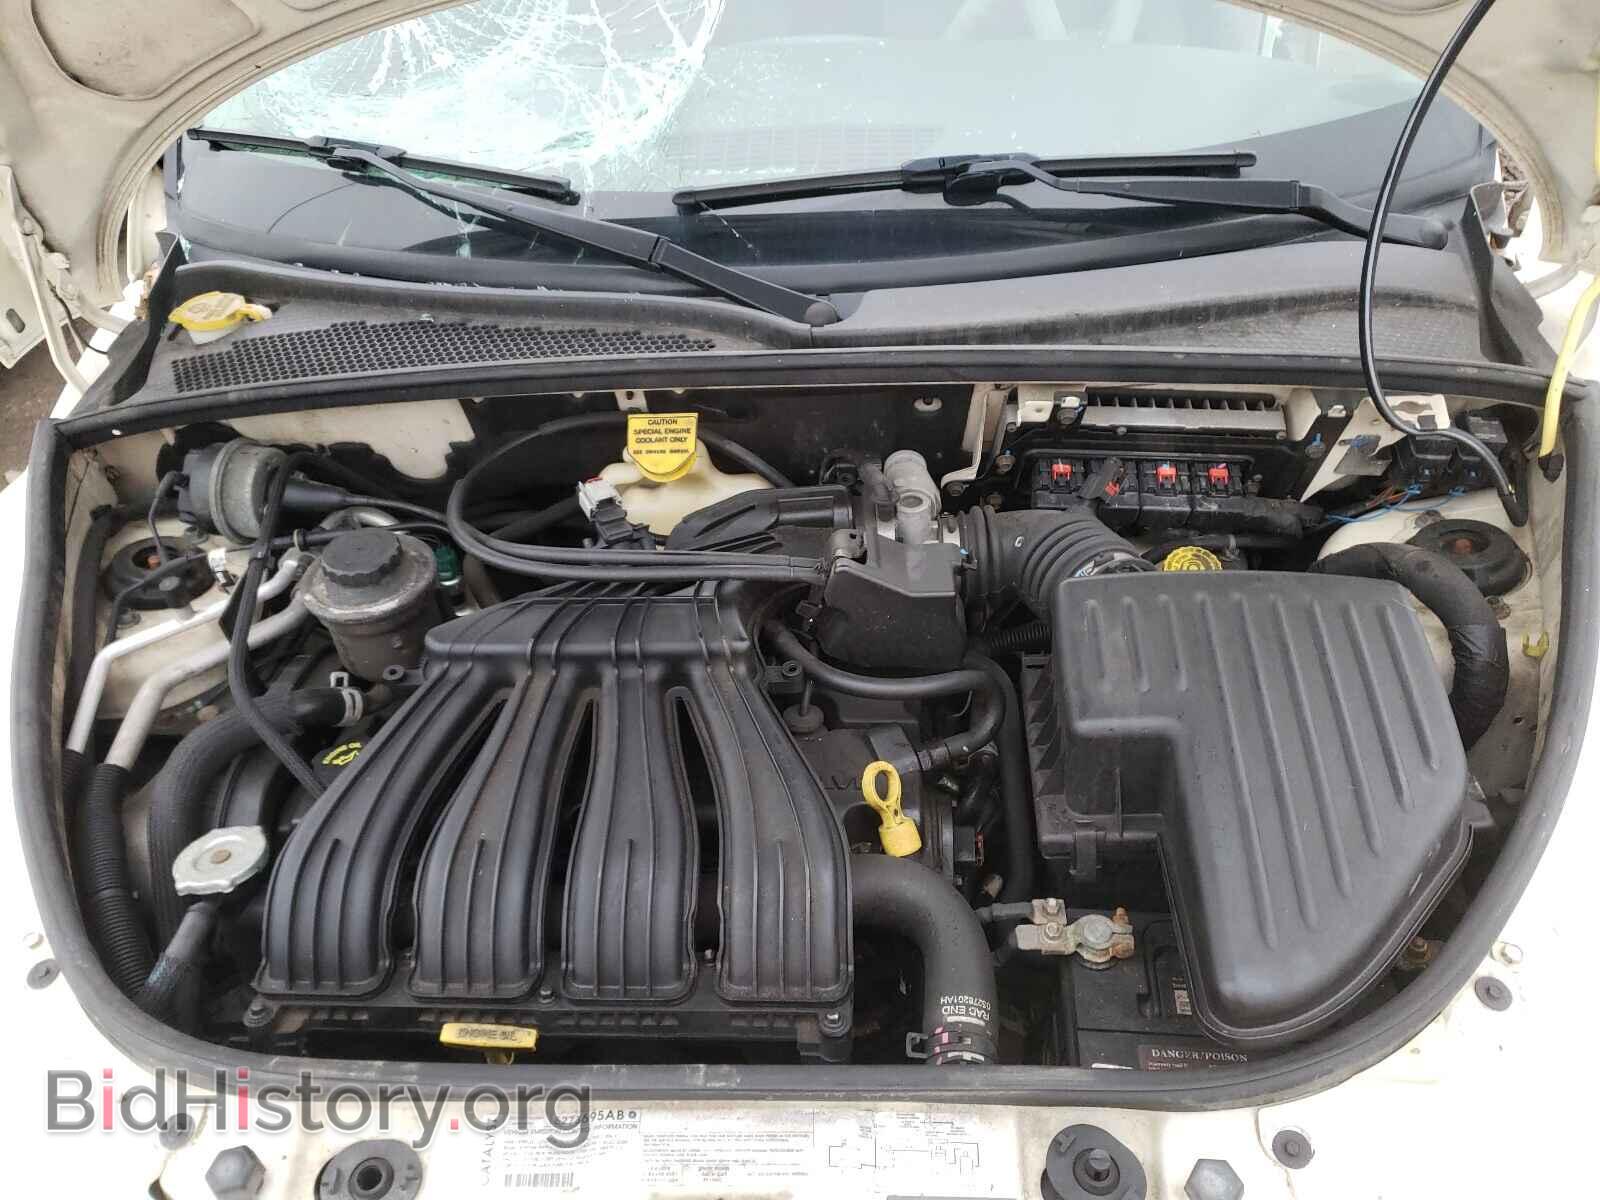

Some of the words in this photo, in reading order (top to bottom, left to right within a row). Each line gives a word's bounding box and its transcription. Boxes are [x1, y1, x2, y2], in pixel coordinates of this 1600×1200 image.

[647, 418, 678, 426] CAUTION
[635, 436, 668, 444] COOLANT
[942, 1005, 966, 1015] END
[968, 1006, 990, 1021] RAD
